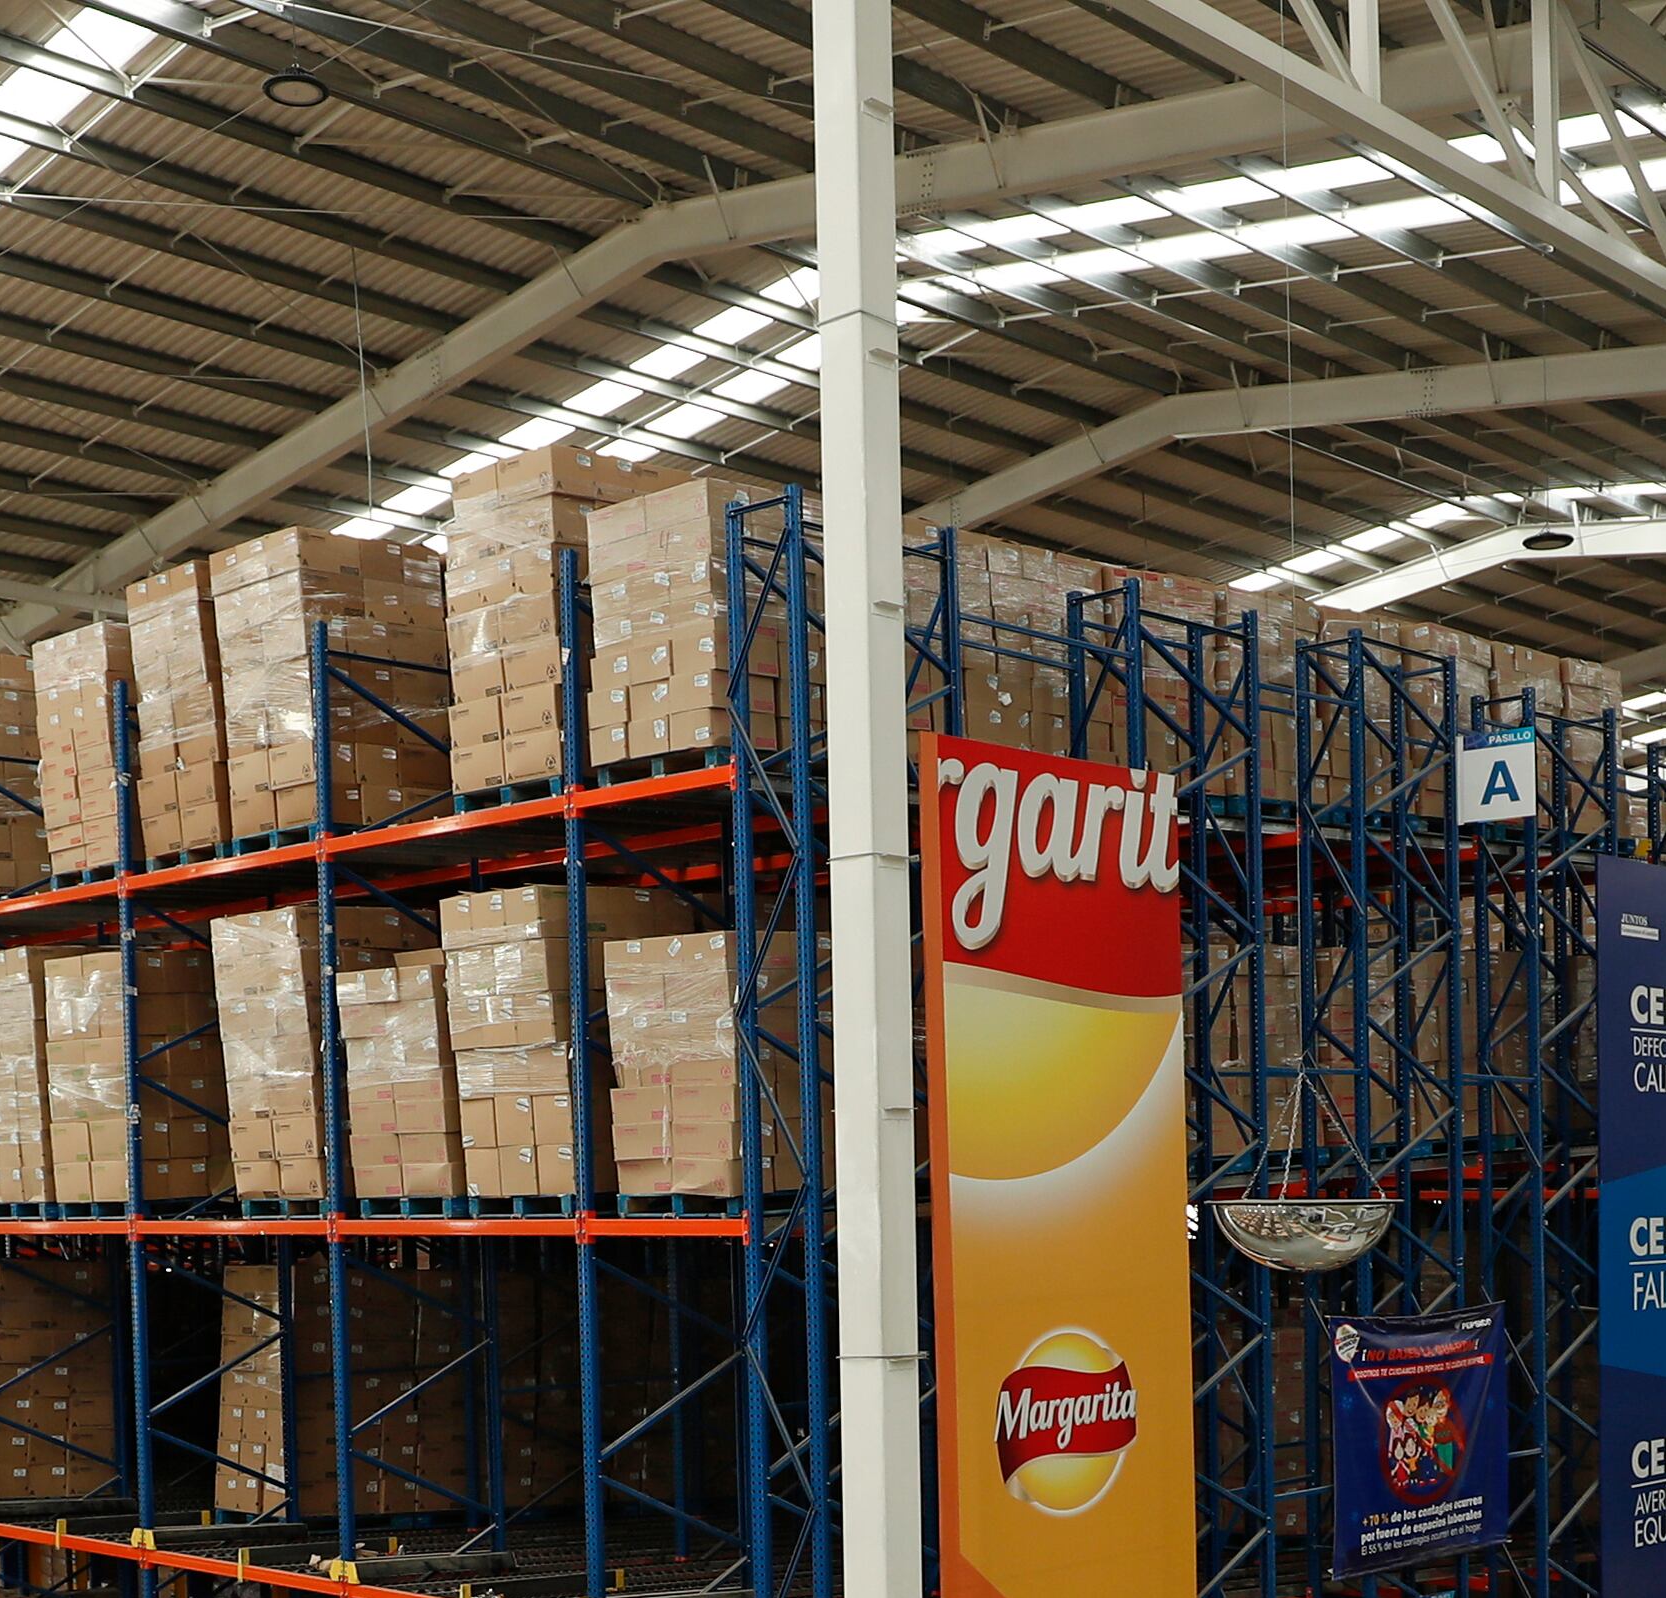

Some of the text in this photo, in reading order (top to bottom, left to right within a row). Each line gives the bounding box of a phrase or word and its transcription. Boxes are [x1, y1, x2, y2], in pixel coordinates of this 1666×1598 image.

[1488, 731, 1531, 745] PASILLO
[1480, 760, 1521, 805] A
[1621, 913, 1648, 926] JUNTOS
[1461, 1318, 1492, 1330] PEPSICO
[1388, 1347, 1421, 1361] BAJES
[994, 1380, 1137, 1450] Margarita
[1390, 1511, 1402, 1523] de
[1403, 1509, 1416, 1520] los
[1417, 1501, 1453, 1518] contagios
[1453, 1496, 1483, 1509] ocurren
[1360, 1509, 1482, 1545] por fuera de espacios laborales
[1368, 1543, 1377, 1554] 55
[1384, 1541, 1392, 1551] de
[1393, 1538, 1402, 1548] los
